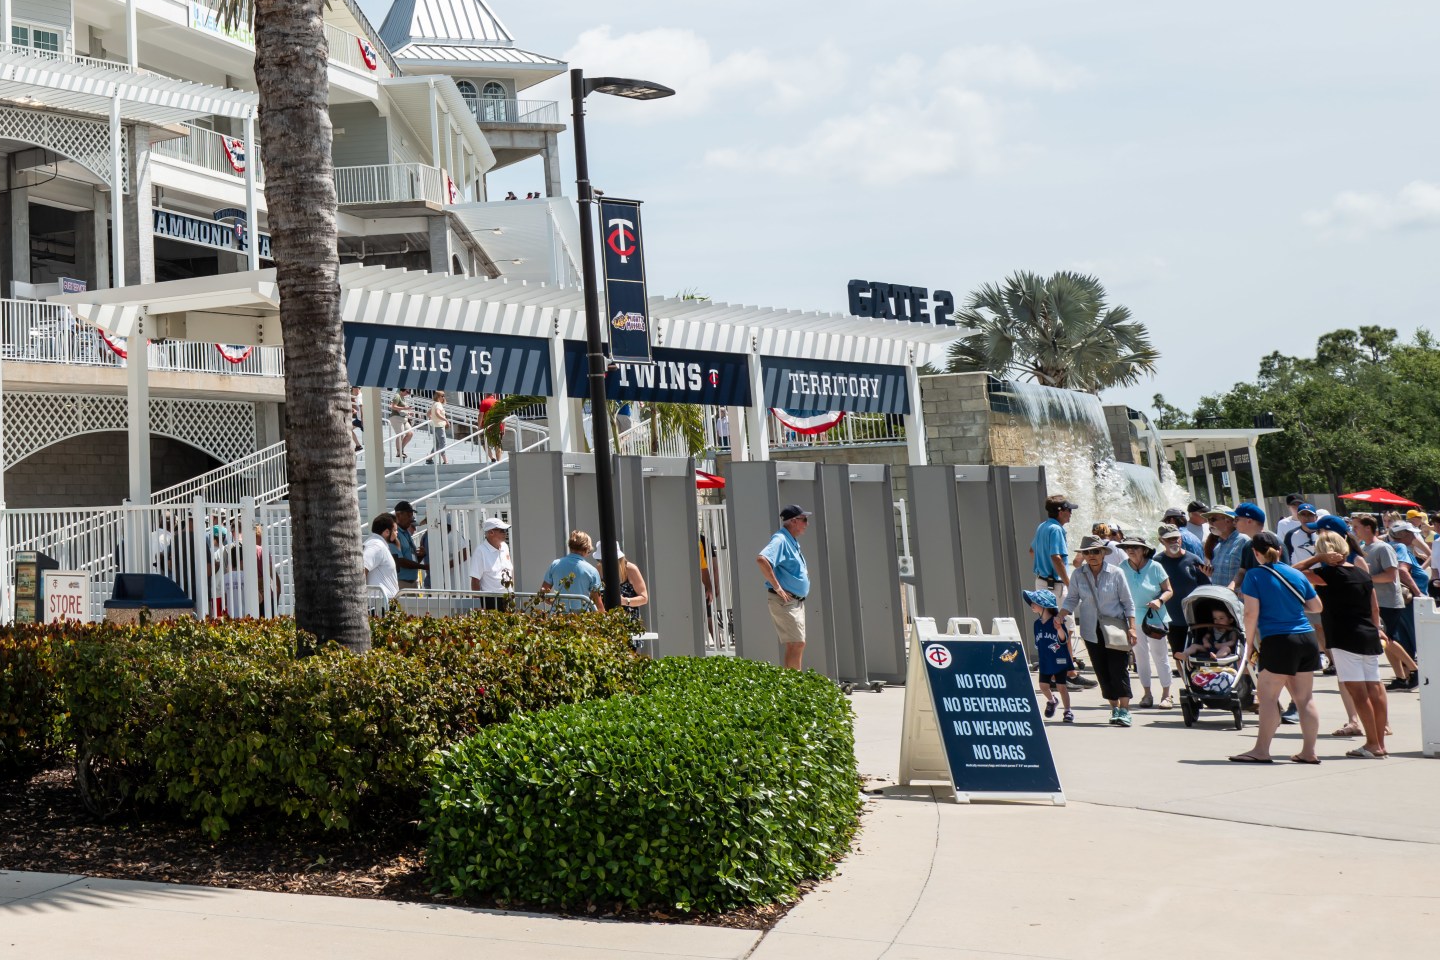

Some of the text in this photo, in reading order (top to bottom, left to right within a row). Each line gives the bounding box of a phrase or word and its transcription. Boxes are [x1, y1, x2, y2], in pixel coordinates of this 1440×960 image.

[152, 211, 233, 249] AMMOND
[848, 279, 956, 327] GATE 2
[394, 344, 493, 375] THIS IS
[616, 360, 703, 391] TWINS
[788, 372, 879, 398] TERRITORY
[50, 593, 83, 615] STORE
[955, 673, 1007, 689] NO FOOD
[942, 696, 1032, 713] NO BEVERAGES
[952, 720, 1033, 737] NO WEAPONS
[972, 744, 1027, 760] NO BAGS
